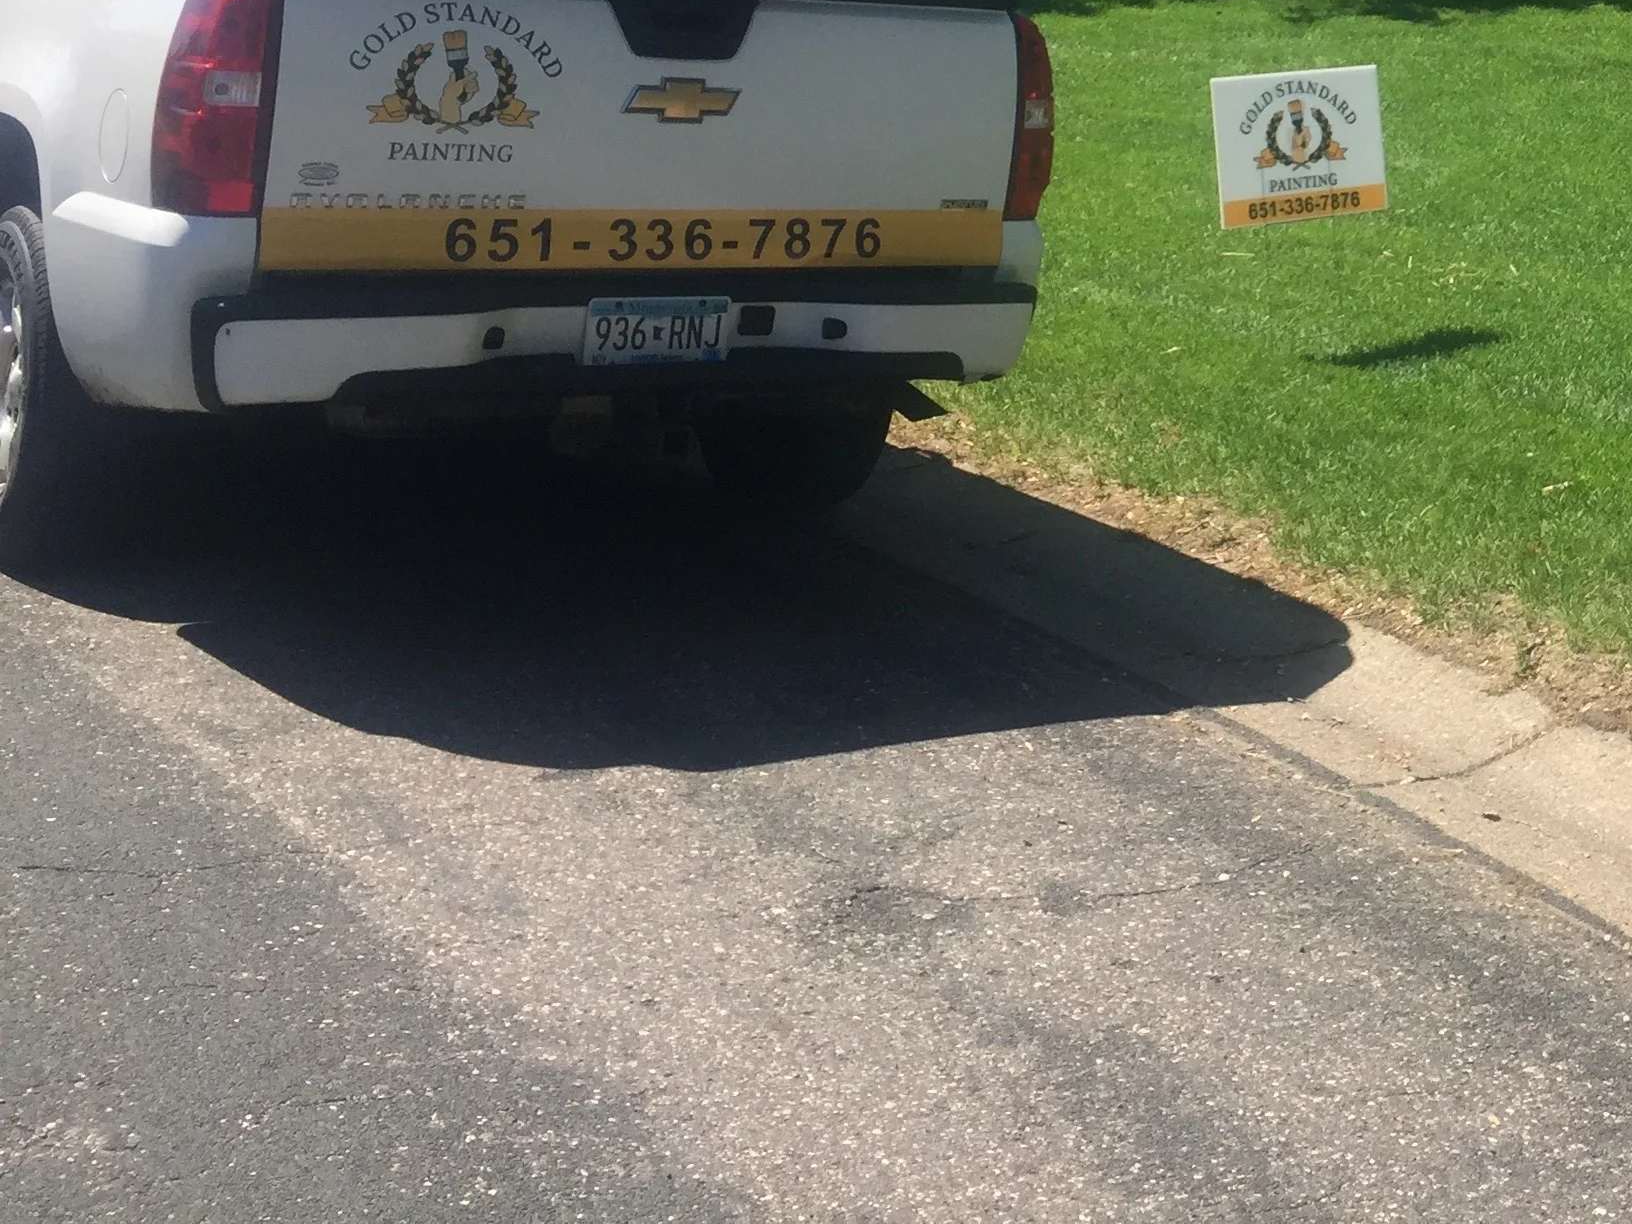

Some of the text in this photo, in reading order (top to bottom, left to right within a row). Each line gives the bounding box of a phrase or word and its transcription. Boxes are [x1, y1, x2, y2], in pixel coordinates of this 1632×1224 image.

[349, 1, 563, 78] GOLD STANDARD
[1239, 80, 1358, 136] GOLD STANDARD
[387, 141, 514, 163] PAINTING
[1269, 172, 1339, 194] PAINTING
[290, 192, 526, 209] AVALANCHE
[1248, 191, 1361, 220] 651-336-7876
[444, 217, 882, 263] 651-336-7876
[595, 315, 722, 351] 936 RNJ
